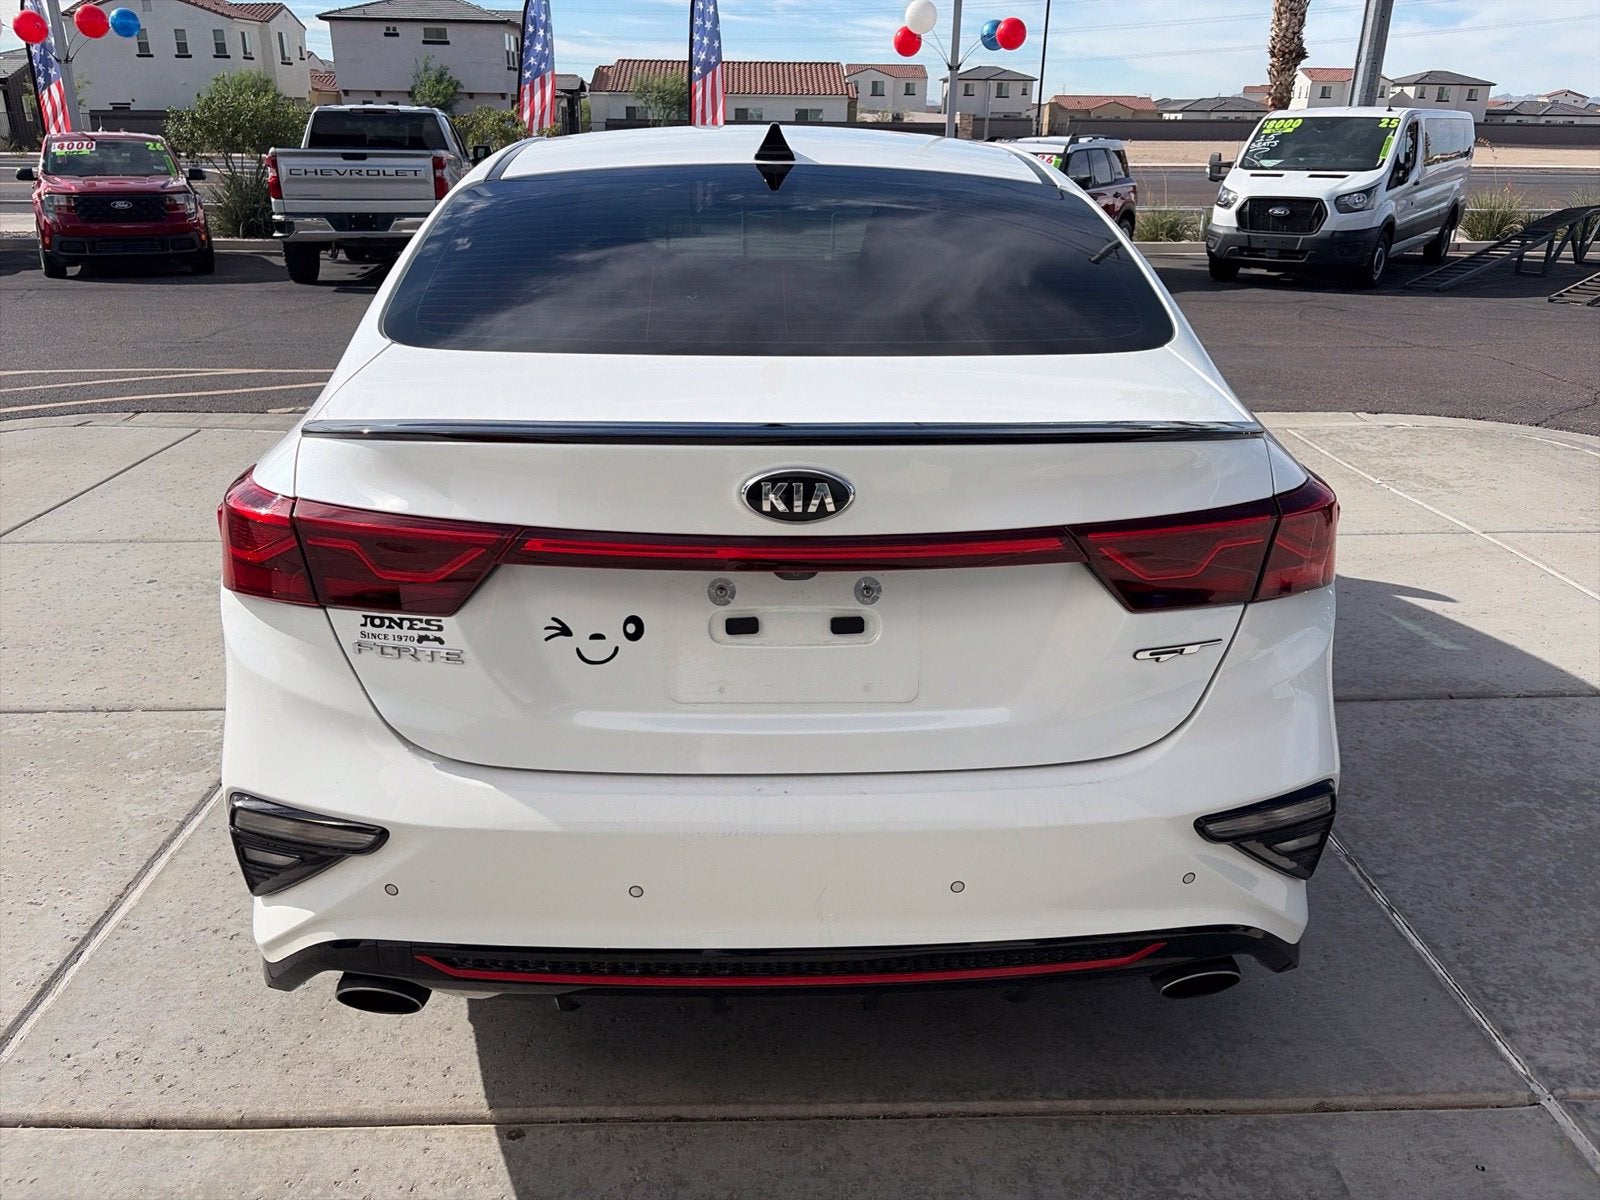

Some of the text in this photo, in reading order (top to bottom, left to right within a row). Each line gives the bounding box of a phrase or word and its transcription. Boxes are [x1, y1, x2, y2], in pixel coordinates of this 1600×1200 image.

[1378, 118, 1400, 128] 25
[145, 142, 165, 151] 26
[289, 168, 422, 177] CHEVROLET
[761, 482, 836, 513] KIA
[360, 614, 444, 632] JONES
[392, 634, 415, 642] 1970
[352, 640, 465, 665] FORTE
